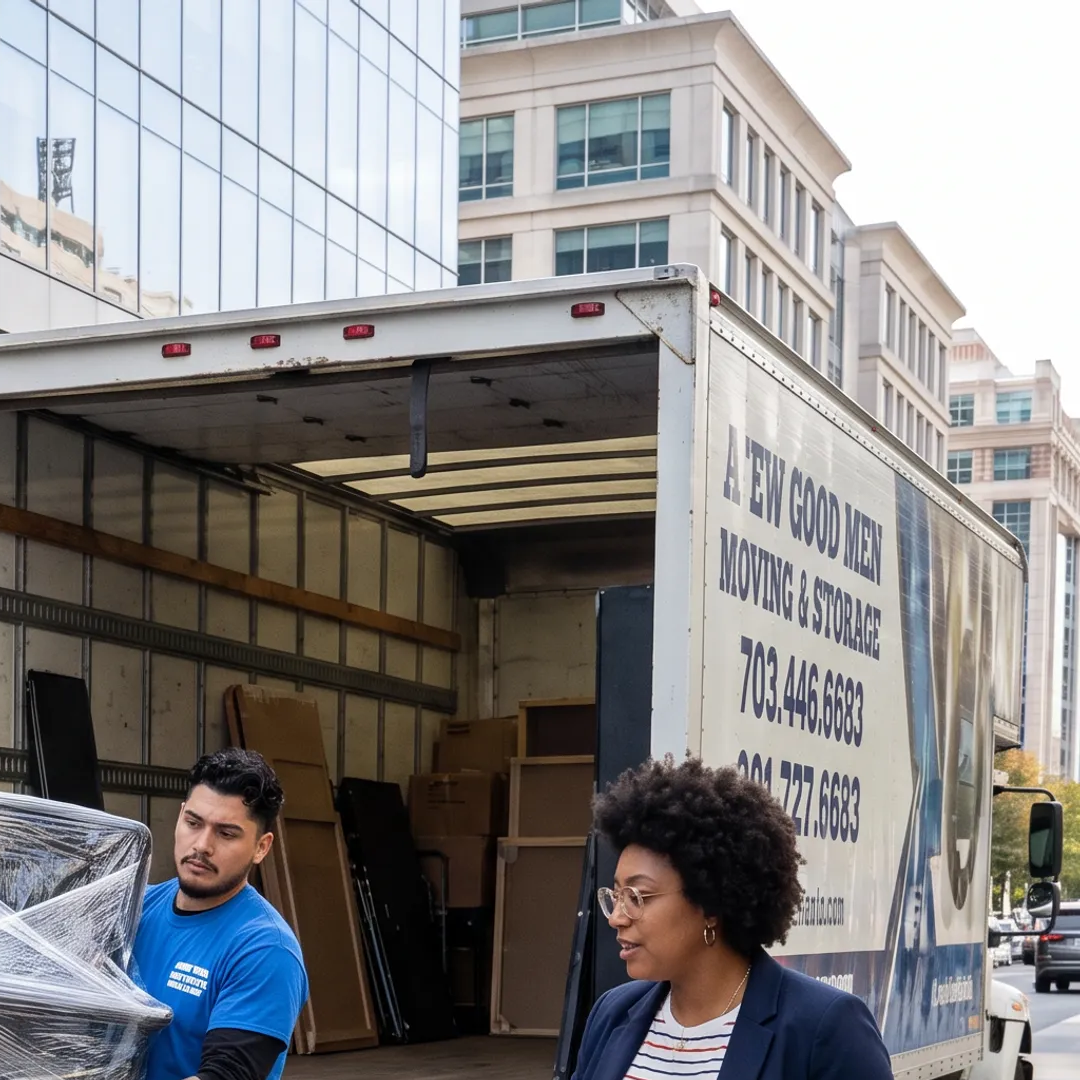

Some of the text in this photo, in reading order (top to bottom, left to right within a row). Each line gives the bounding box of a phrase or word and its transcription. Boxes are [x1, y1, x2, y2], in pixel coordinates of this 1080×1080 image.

[723, 423, 883, 586] A EW GOOD MEN
[719, 527, 881, 661] MOVING & STORAGE
[740, 635, 863, 747] 703.446.6683
